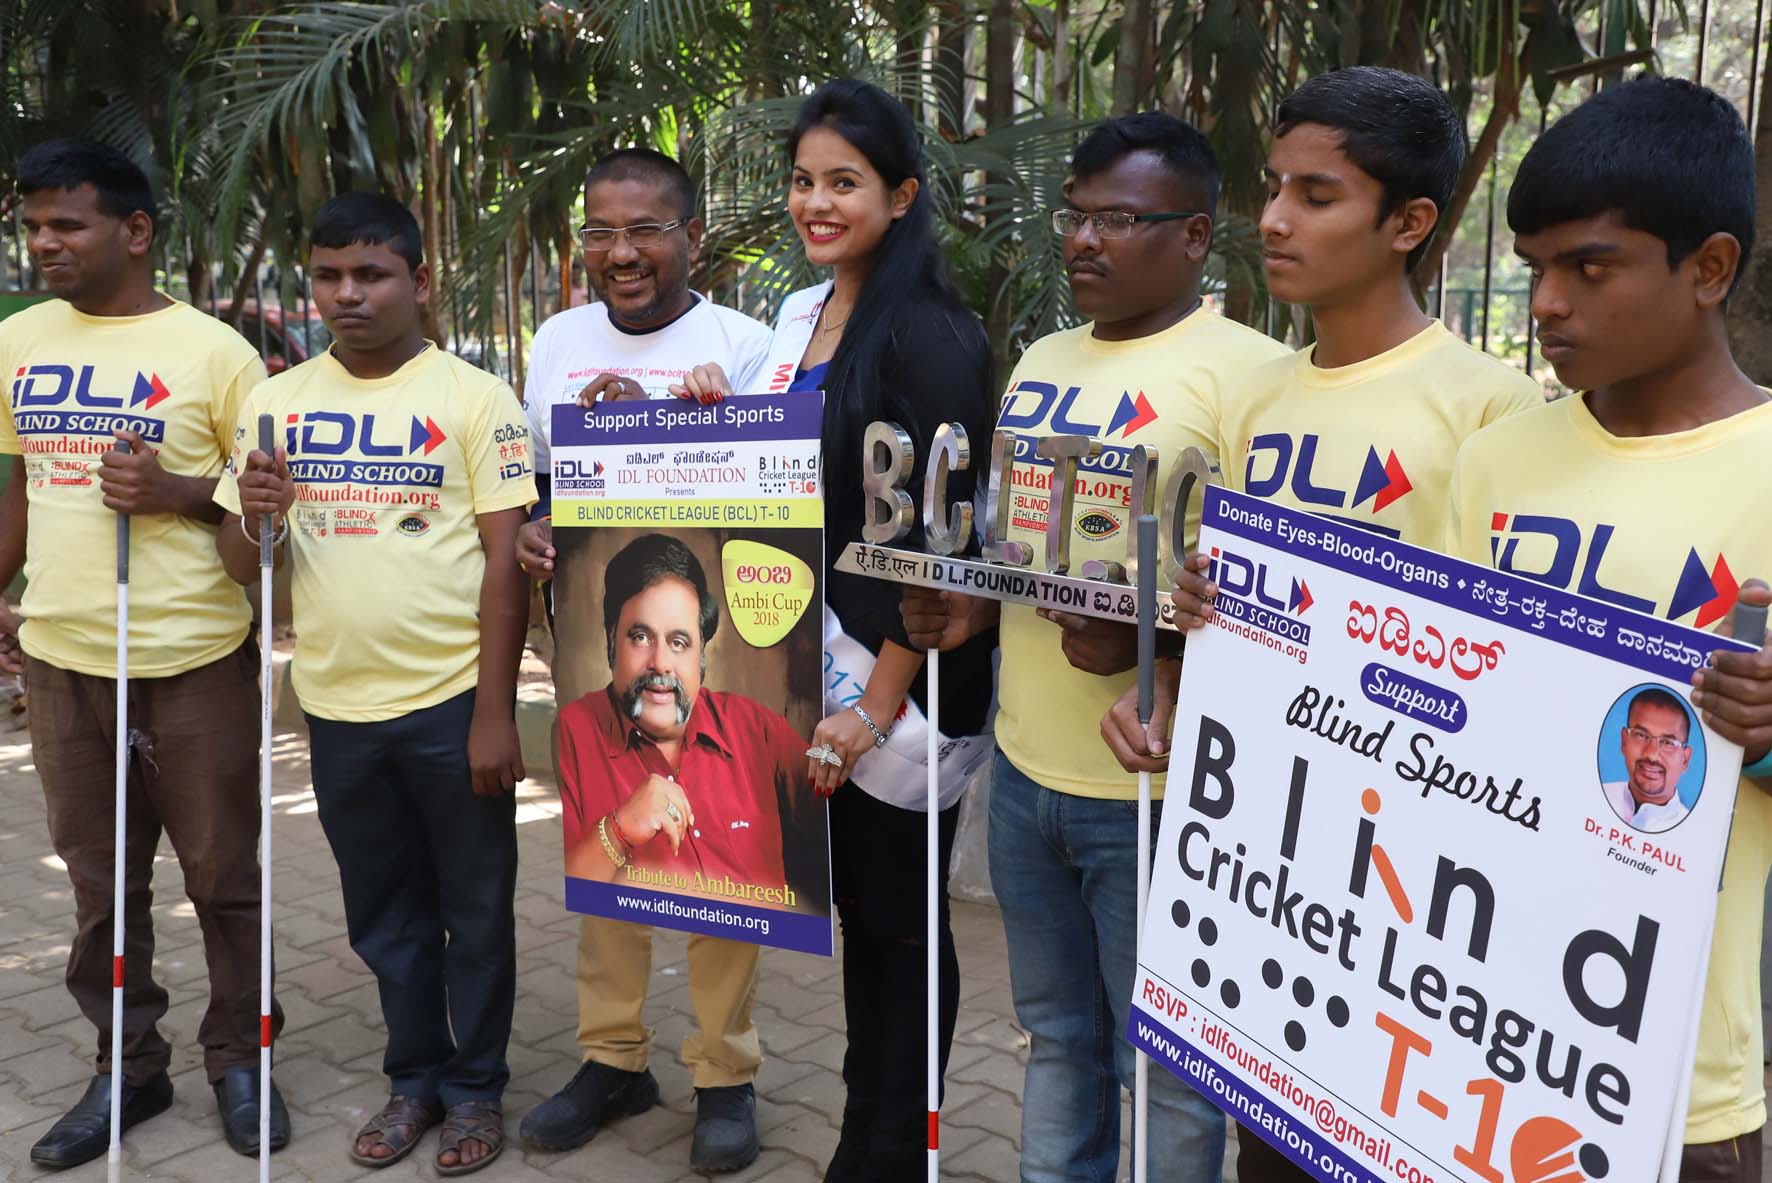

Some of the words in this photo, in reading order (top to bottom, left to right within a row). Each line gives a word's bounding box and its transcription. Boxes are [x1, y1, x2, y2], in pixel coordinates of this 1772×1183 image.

[66, 415, 160, 439] SCHOOL
[584, 411, 649, 432] Support
[655, 408, 718, 429] Special
[724, 405, 785, 428] Sports
[350, 465, 440, 483] SCHOOL
[555, 480, 574, 488] BLIND
[576, 480, 604, 488] SCHOOL
[617, 469, 641, 484] IDL
[647, 467, 746, 484] FOUNDATION
[759, 470, 786, 480] Cricket
[788, 470, 817, 481] League
[665, 486, 696, 496] Presents
[578, 507, 615, 520] BLIND
[616, 506, 667, 520] CRICKET
[670, 506, 720, 520] LEAGUE
[723, 504, 758, 522] (BCL)
[1219, 500, 1272, 535] Donate
[1277, 517, 1449, 590] Eyes-Blood-Organs
[736, 565, 792, 585] ಅಂಬಿ
[731, 592, 769, 610] Ambi
[772, 592, 803, 616] Cup
[753, 612, 779, 626] 2018
[1214, 595, 1244, 617] LIND
[1249, 608, 1308, 643] SCHOOL
[1346, 600, 1506, 681] ಐಡಿಎಲ್
[1366, 668, 1460, 723] Support
[1285, 685, 1395, 763] Blind
[1394, 732, 1541, 832] Sports
[1584, 817, 1604, 839] Dr.
[1609, 829, 1636, 851] P.K.
[1642, 842, 1686, 872] PAUL
[1606, 847, 1657, 876] Founder
[624, 865, 673, 888] Tribute
[674, 872, 688, 889] to
[692, 872, 796, 906] Ambareesh
[617, 895, 770, 934] www.idlfoundation.org
[1178, 821, 1361, 972] Cricket
[1376, 927, 1631, 1126] League
[1143, 978, 1188, 1022] RSVP
